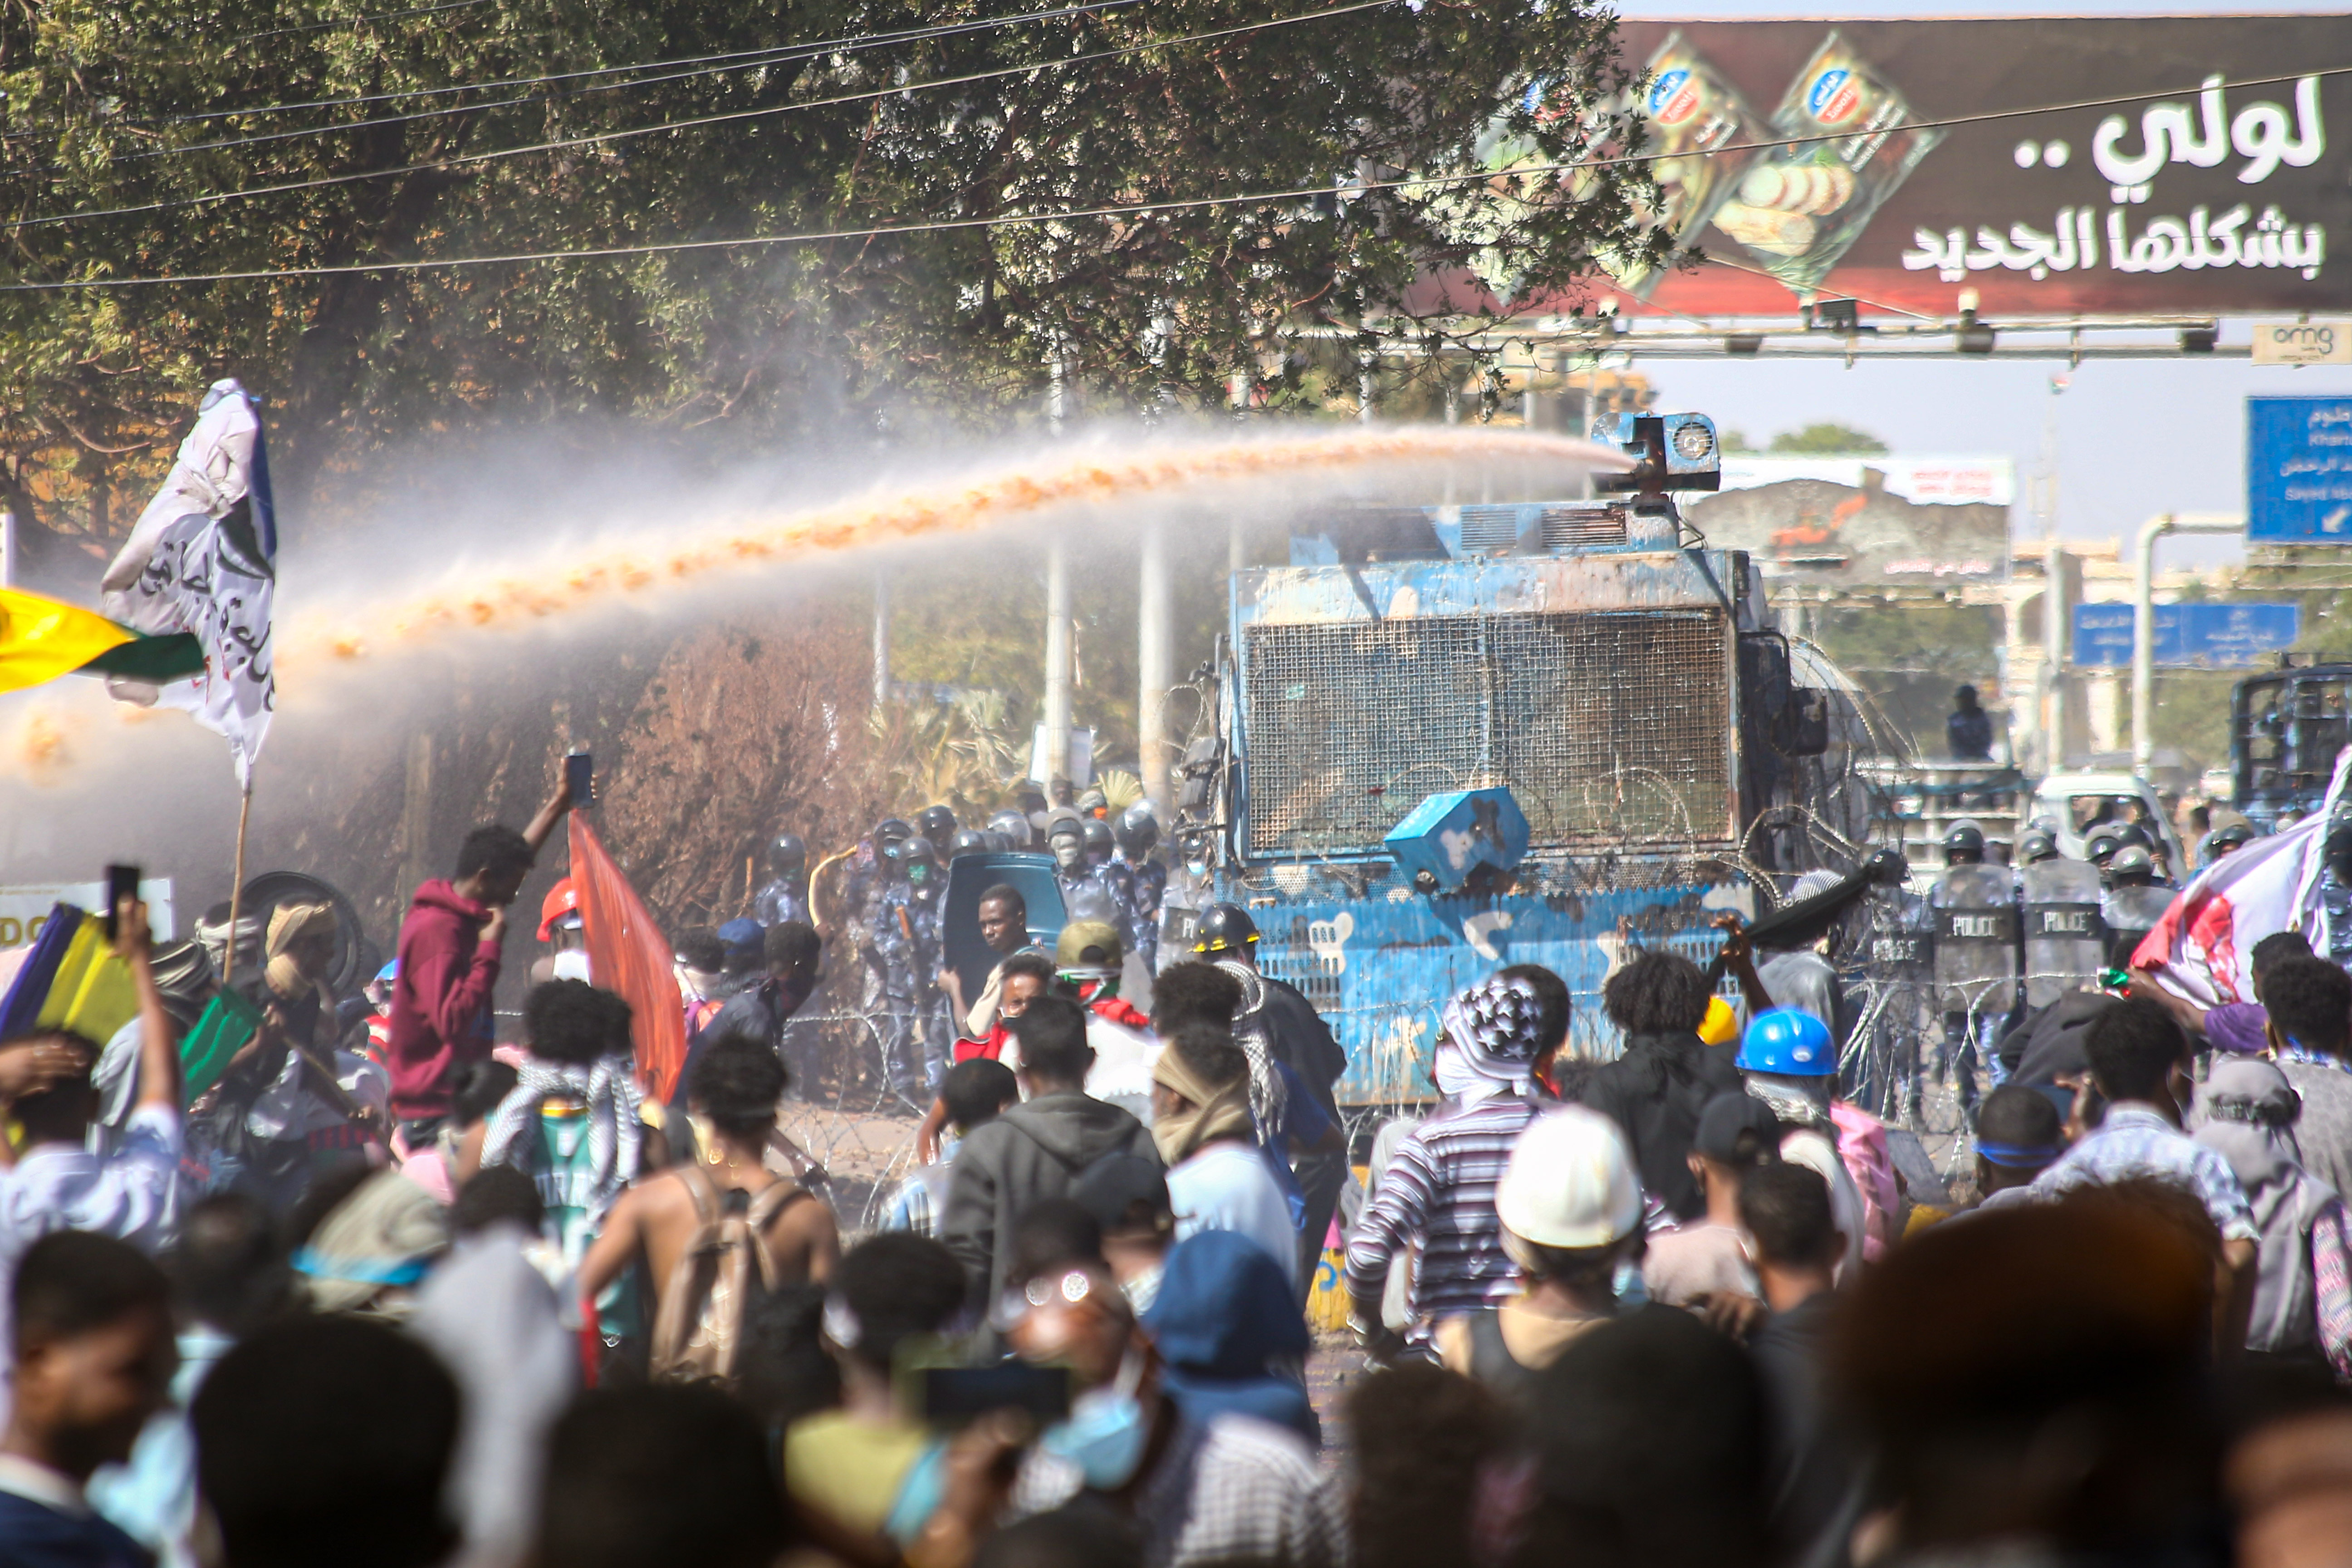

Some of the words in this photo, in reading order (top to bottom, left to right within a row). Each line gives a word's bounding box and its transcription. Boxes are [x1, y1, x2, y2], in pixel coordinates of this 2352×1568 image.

[2092, 74, 2323, 204] لولي
[1901, 207, 2098, 282] الجديد
[2106, 206, 2324, 280] بشكلها
[2274, 328, 2333, 355] omg
[1953, 915, 1996, 937] POLICE
[2044, 911, 2087, 932] POLICE
